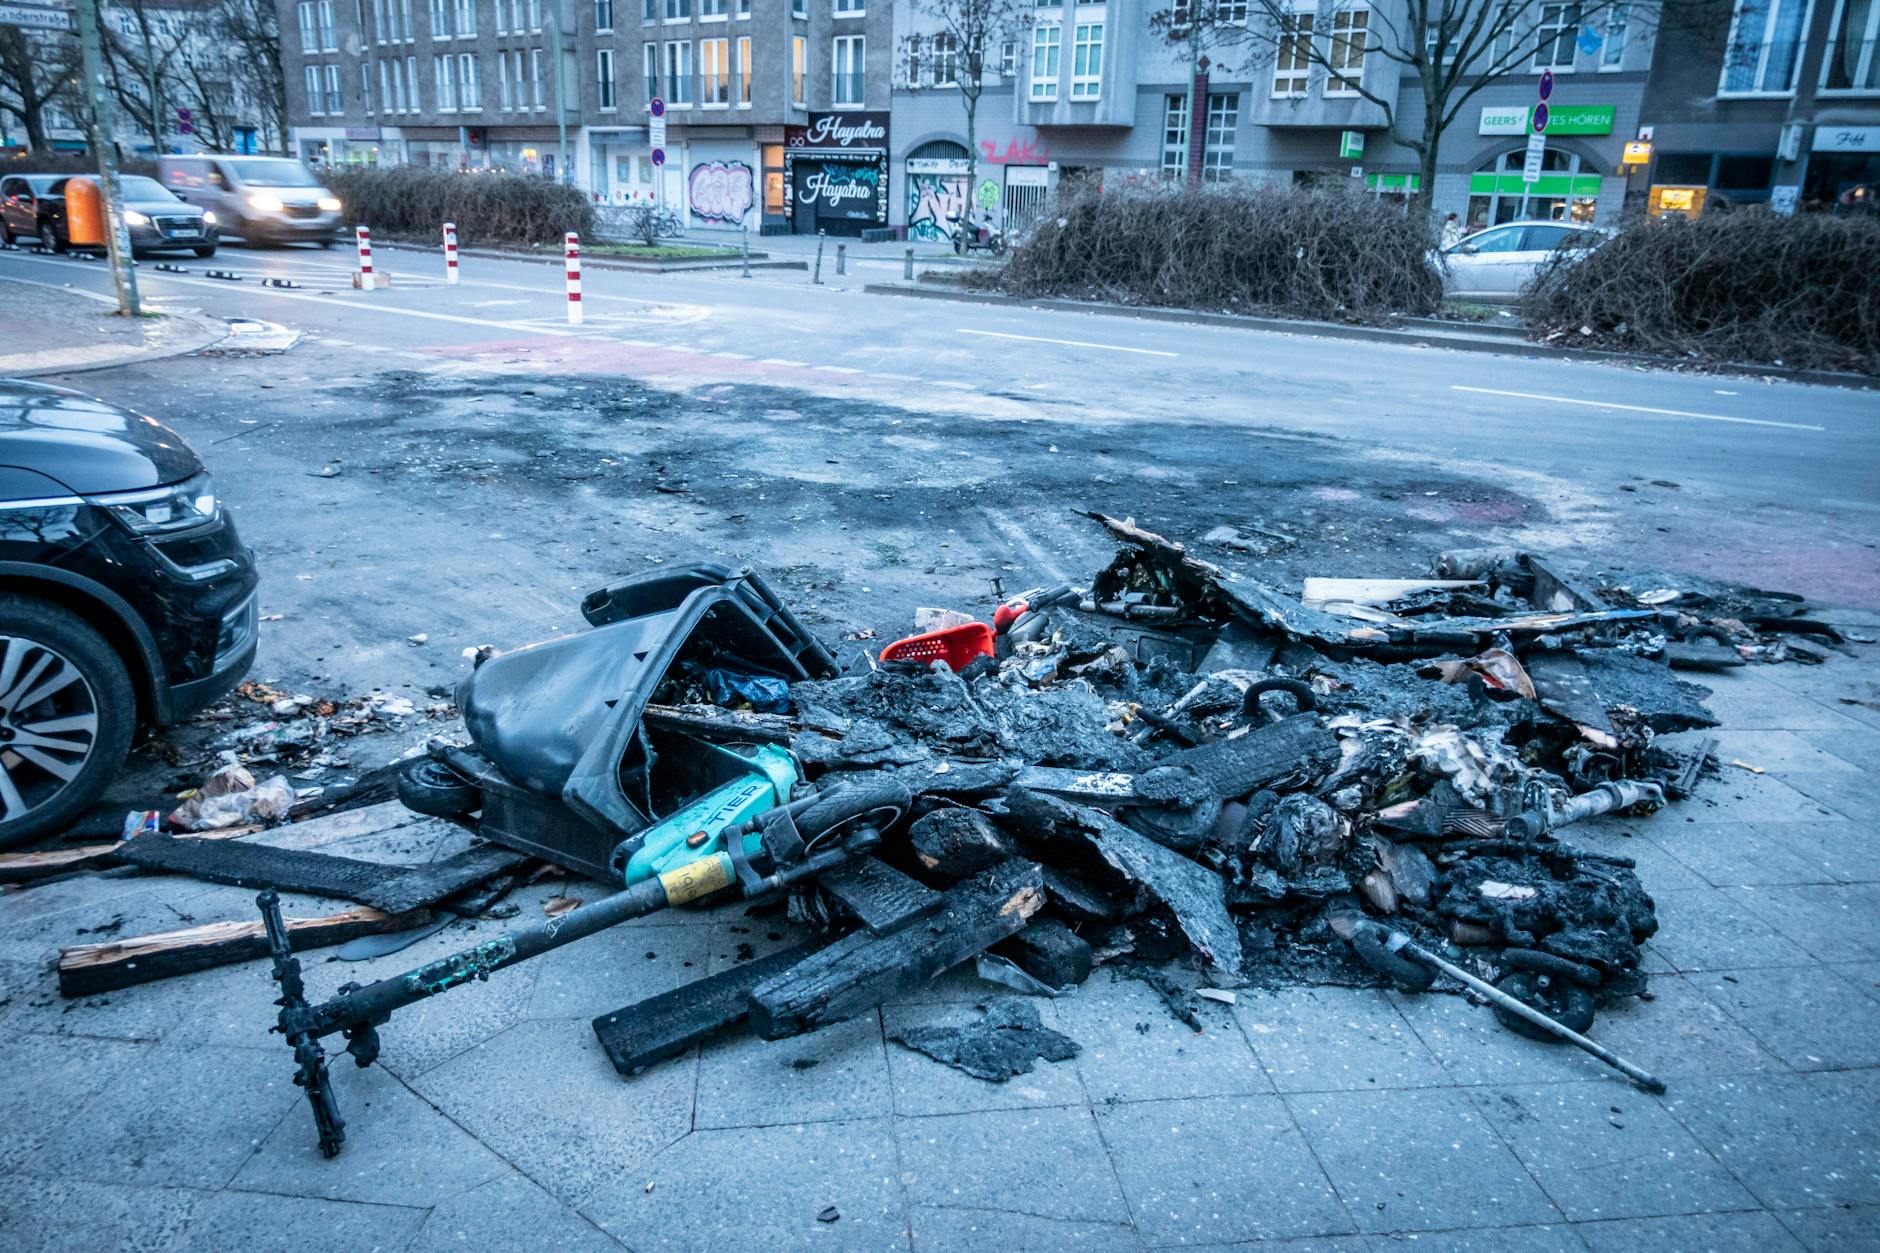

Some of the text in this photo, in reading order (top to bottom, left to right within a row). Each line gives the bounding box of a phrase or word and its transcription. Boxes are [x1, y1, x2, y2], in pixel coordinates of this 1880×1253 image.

[806, 115, 886, 146] Hayatna
[1484, 115, 1517, 126] GEERS
[1568, 113, 1611, 125] HÖREN
[798, 172, 871, 207] Hayatna
[707, 785, 762, 825] TIER
